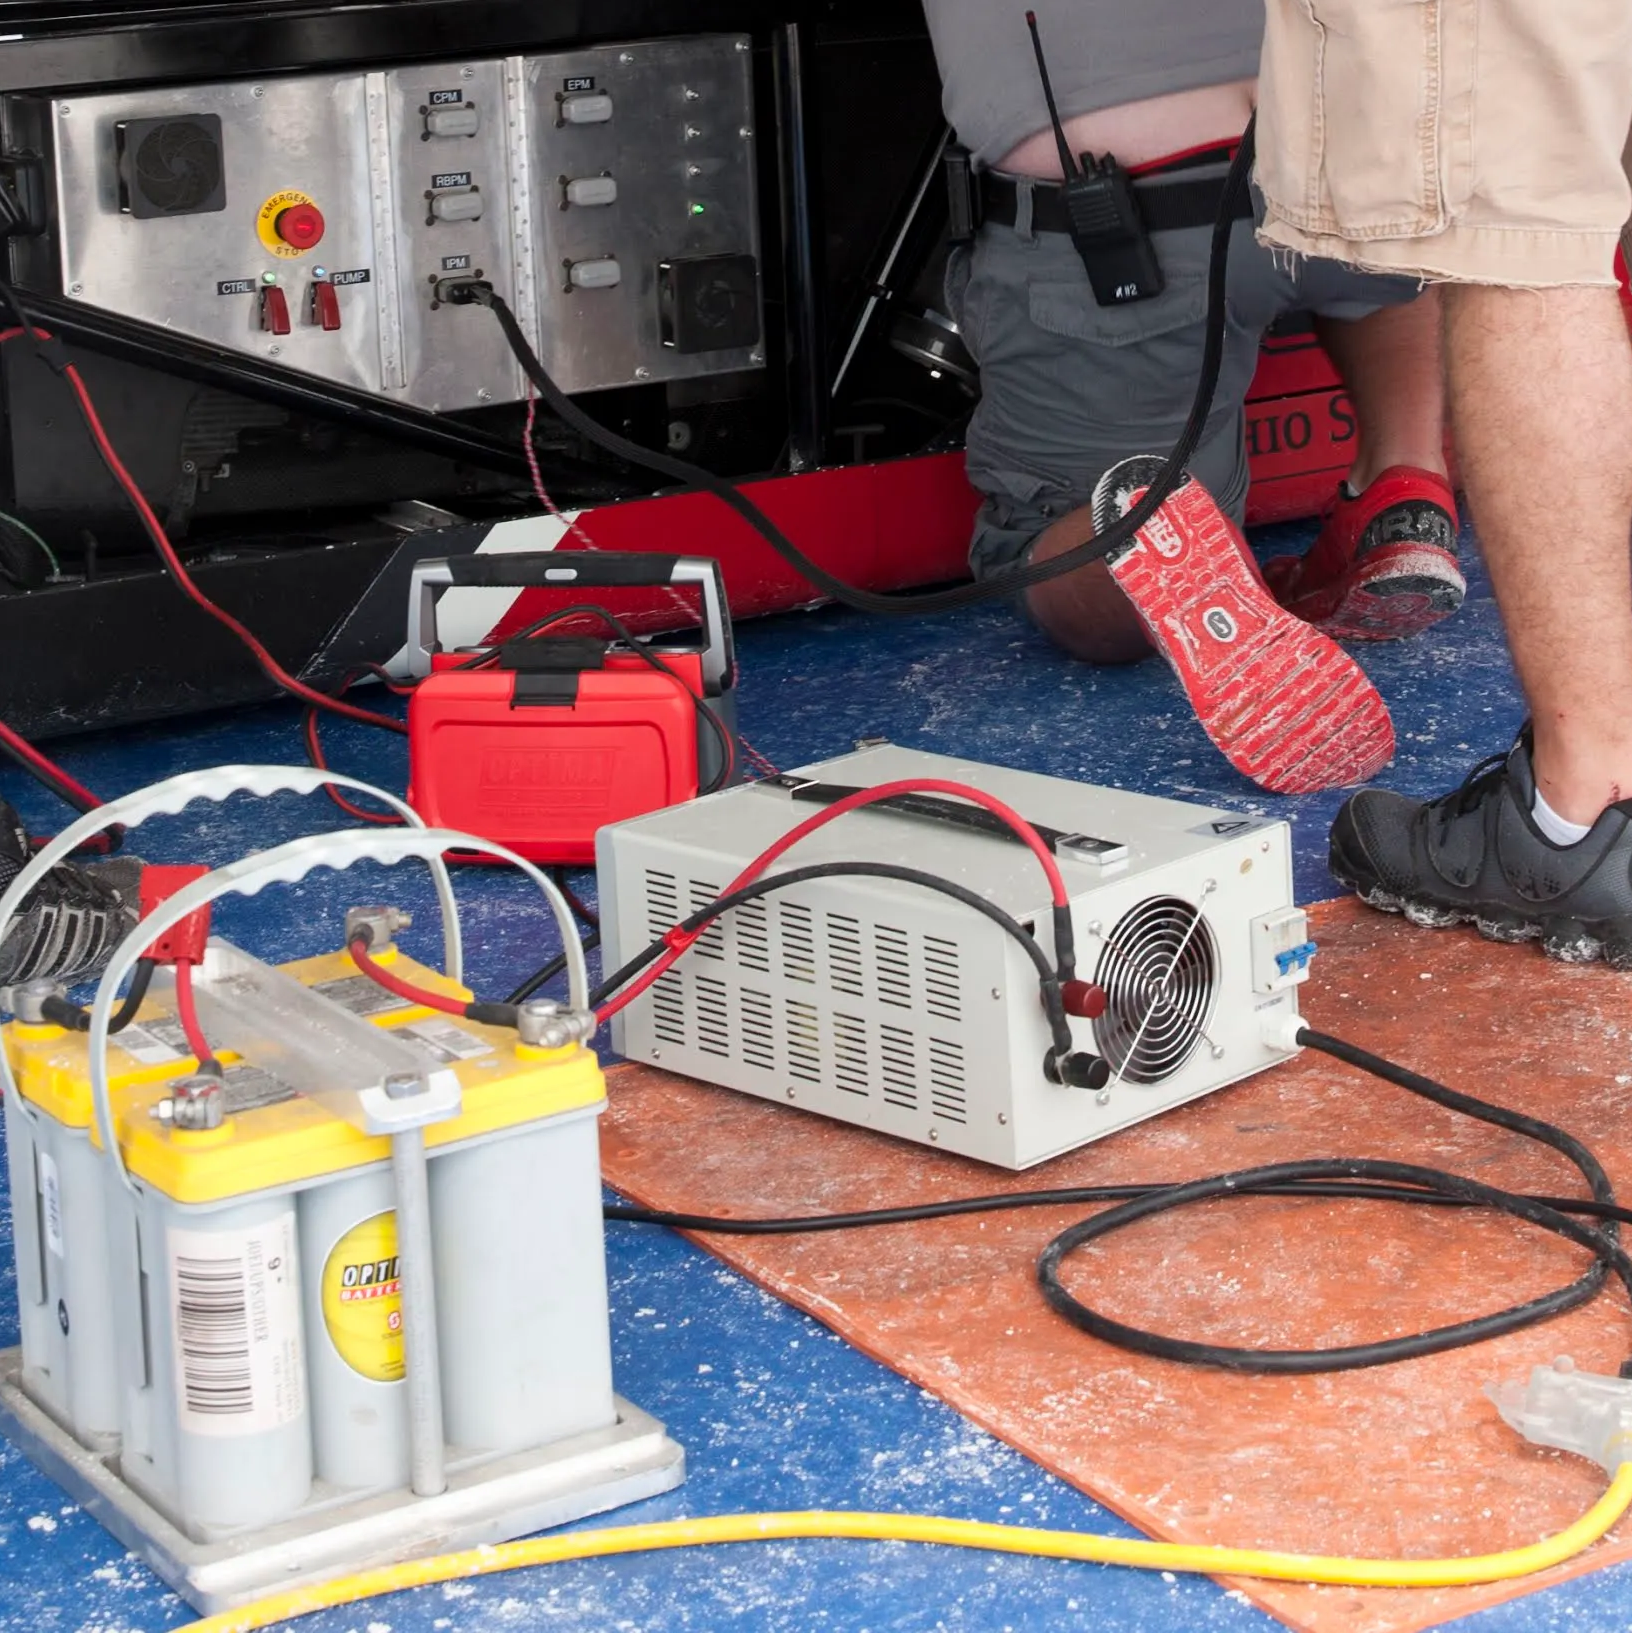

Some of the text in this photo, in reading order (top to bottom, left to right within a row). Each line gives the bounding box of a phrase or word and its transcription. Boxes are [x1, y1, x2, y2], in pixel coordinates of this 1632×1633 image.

[567, 79, 591, 90] EPM
[433, 91, 458, 103] CPM
[435, 174, 467, 186] RBPM
[275, 246, 305, 256] STO
[446, 257, 467, 268] IPM
[334, 271, 366, 285] PUMP
[222, 282, 252, 294] CTRL
